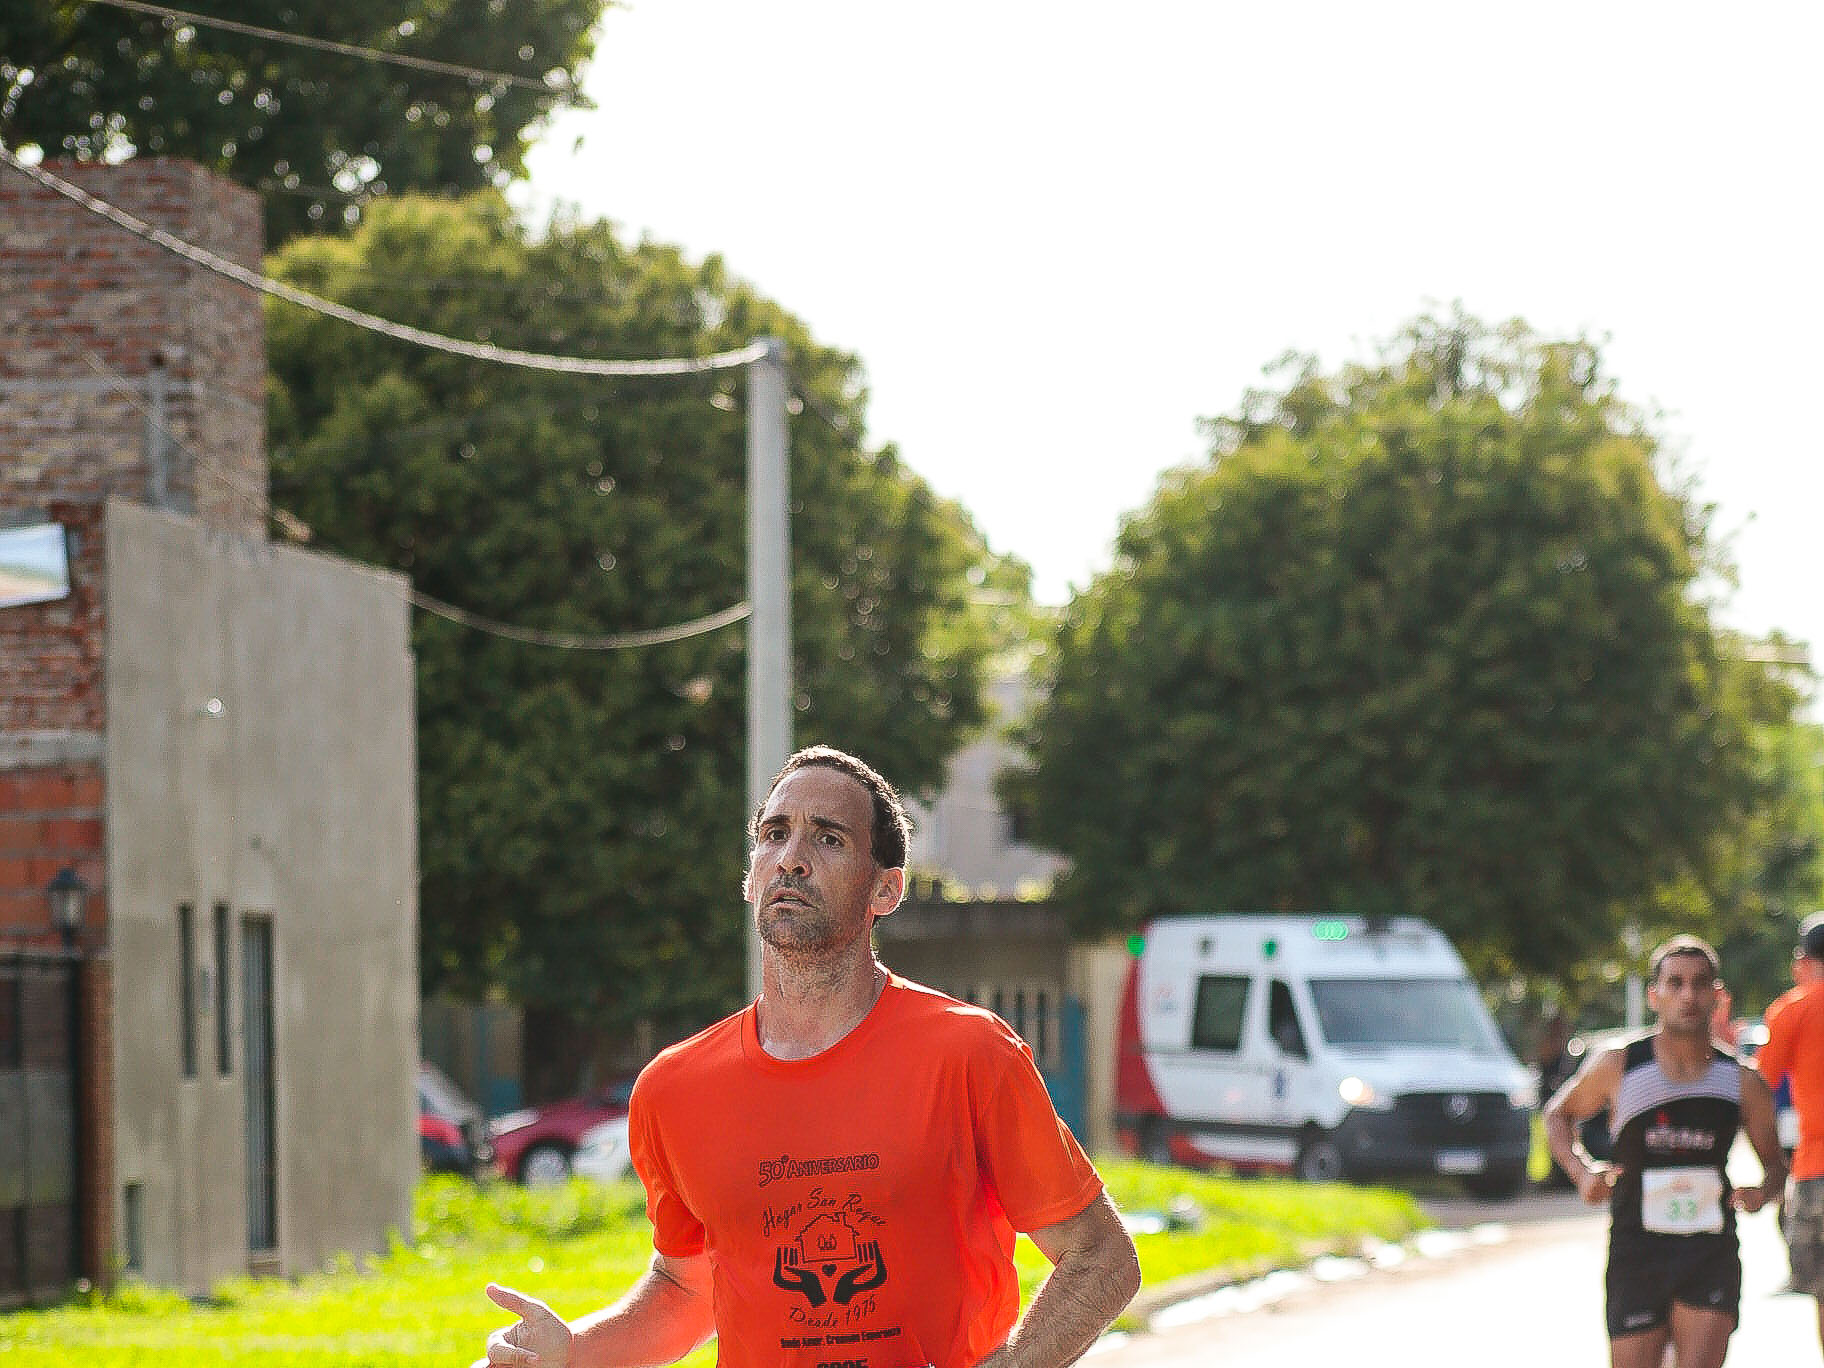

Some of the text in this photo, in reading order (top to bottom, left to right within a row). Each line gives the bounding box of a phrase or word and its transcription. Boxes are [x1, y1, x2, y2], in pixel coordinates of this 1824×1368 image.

[787, 1153, 880, 1178] ANIVERSARIO
[807, 1187, 837, 1209] San
[791, 1307, 838, 1328] Desde
